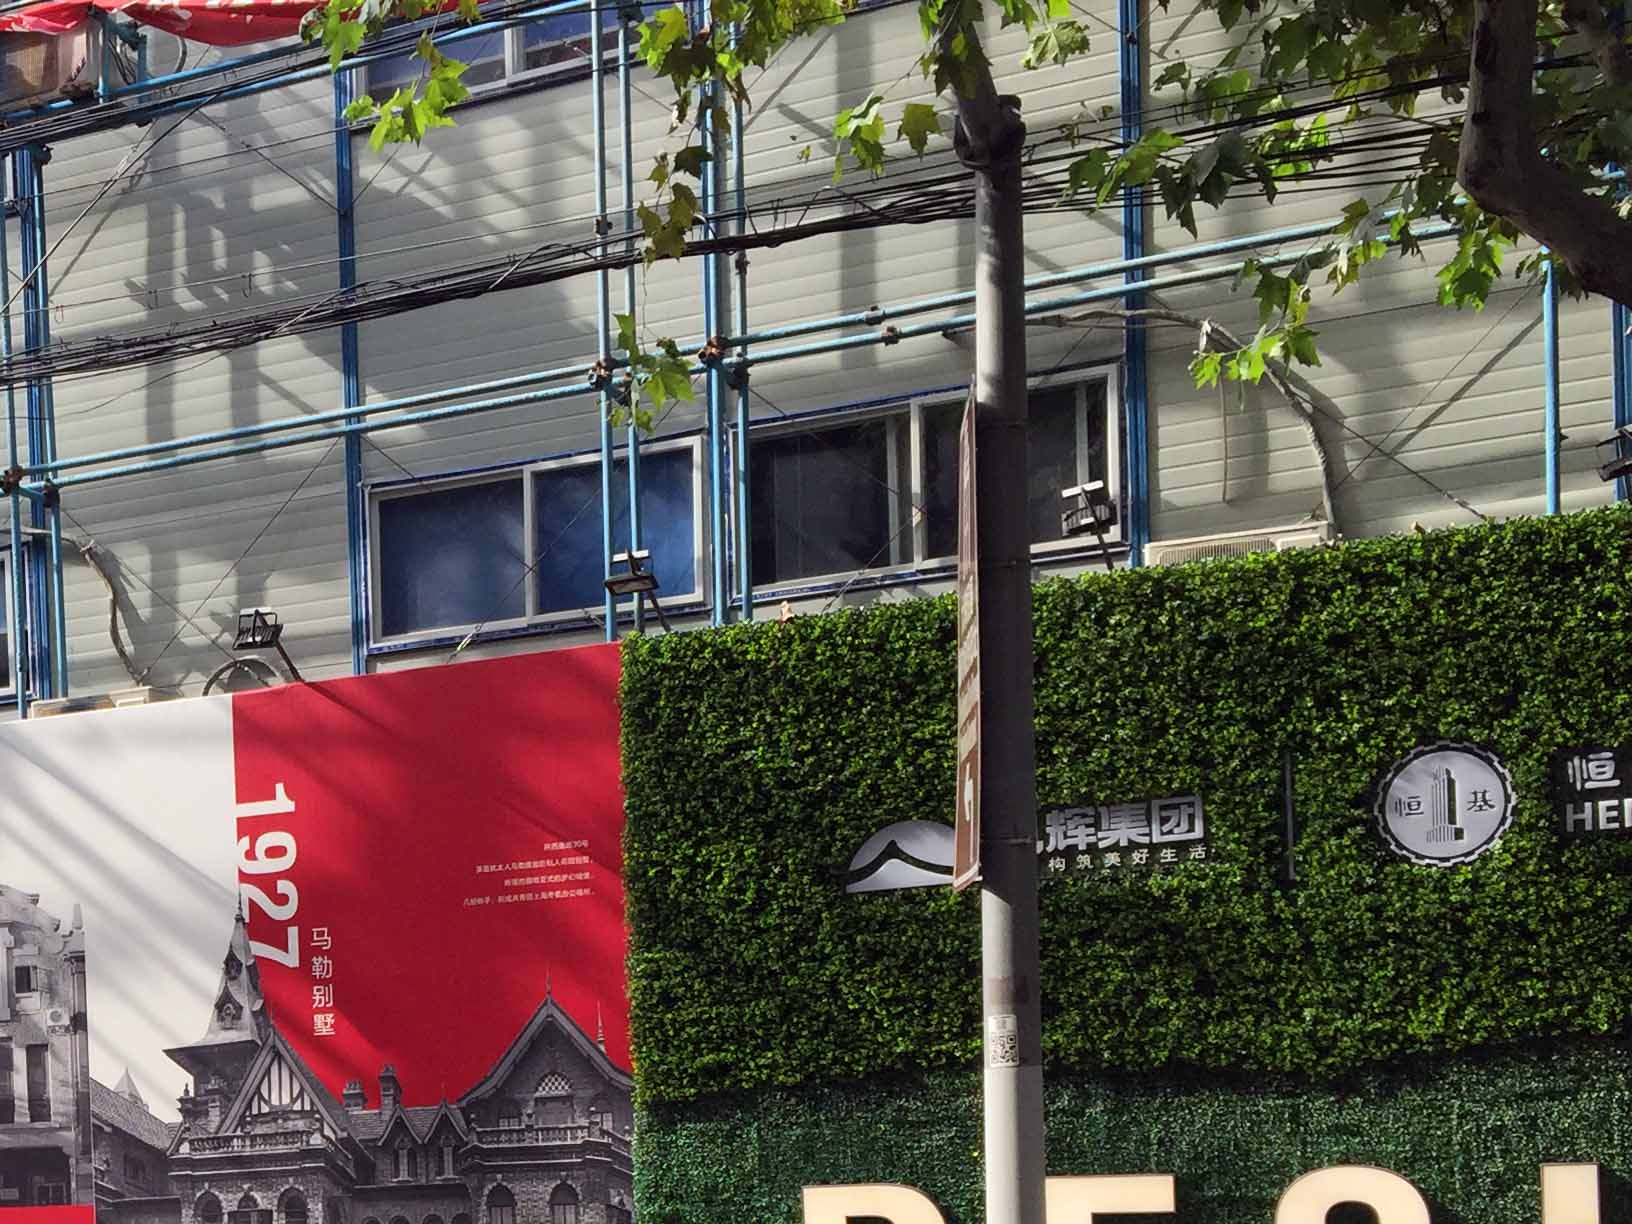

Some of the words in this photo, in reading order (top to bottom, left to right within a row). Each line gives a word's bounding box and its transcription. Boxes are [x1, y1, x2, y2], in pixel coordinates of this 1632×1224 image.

[1035, 795, 1205, 855] 辉集团
[1048, 844, 1207, 873] 构筑美好生活
[236, 783, 300, 969] 1927
[310, 926, 337, 1037] 马勒别墅
